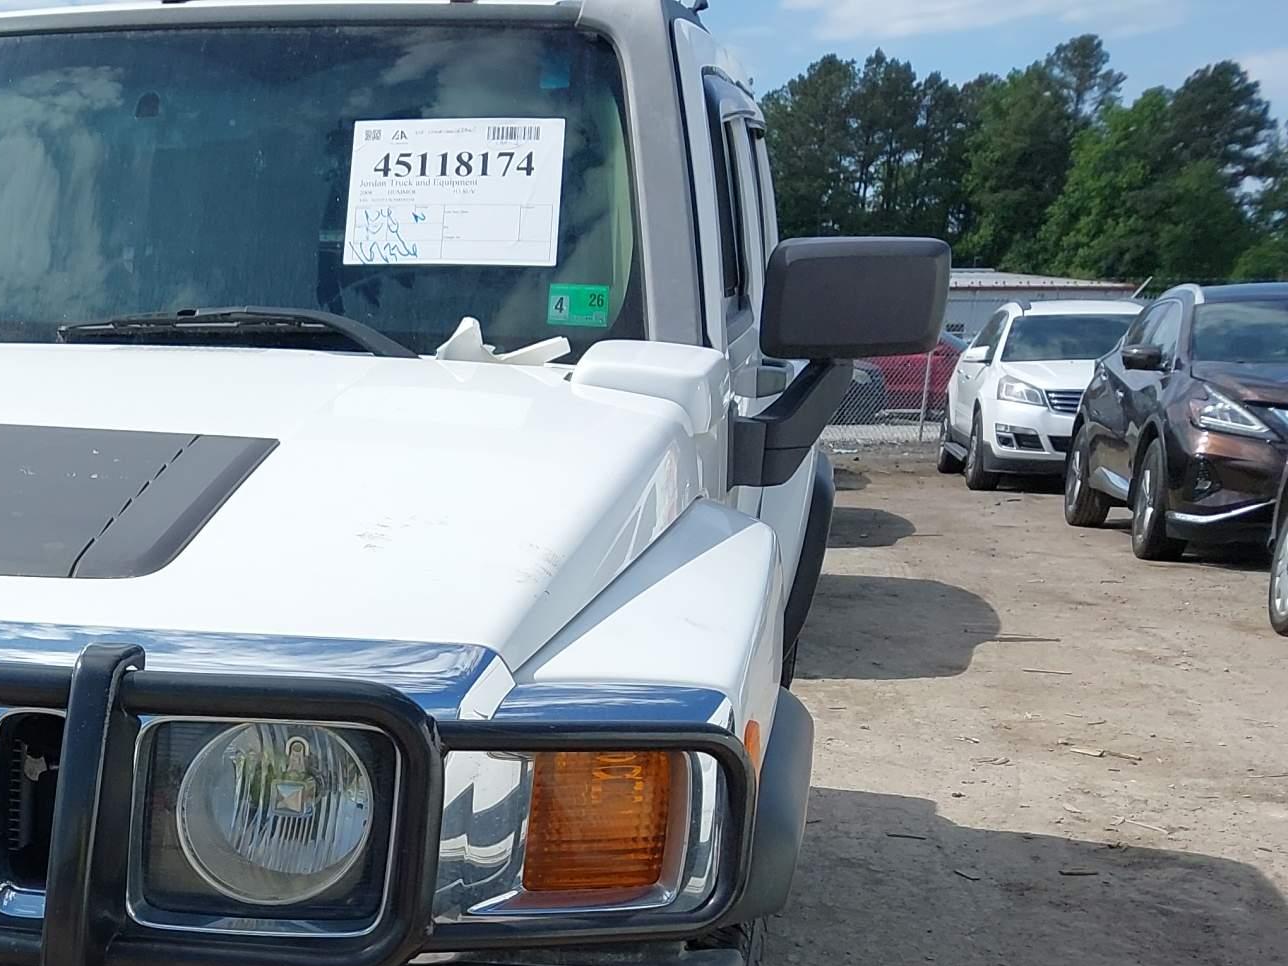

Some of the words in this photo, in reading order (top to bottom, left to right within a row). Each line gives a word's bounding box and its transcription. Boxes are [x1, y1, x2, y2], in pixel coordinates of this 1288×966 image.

[373, 151, 535, 177] 45118174
[359, 179, 387, 188] Jordan
[390, 179, 413, 187] Truck
[415, 179, 431, 187] and
[433, 179, 478, 189] Equipment
[554, 296, 565, 314] 4
[589, 293, 605, 308] 26
